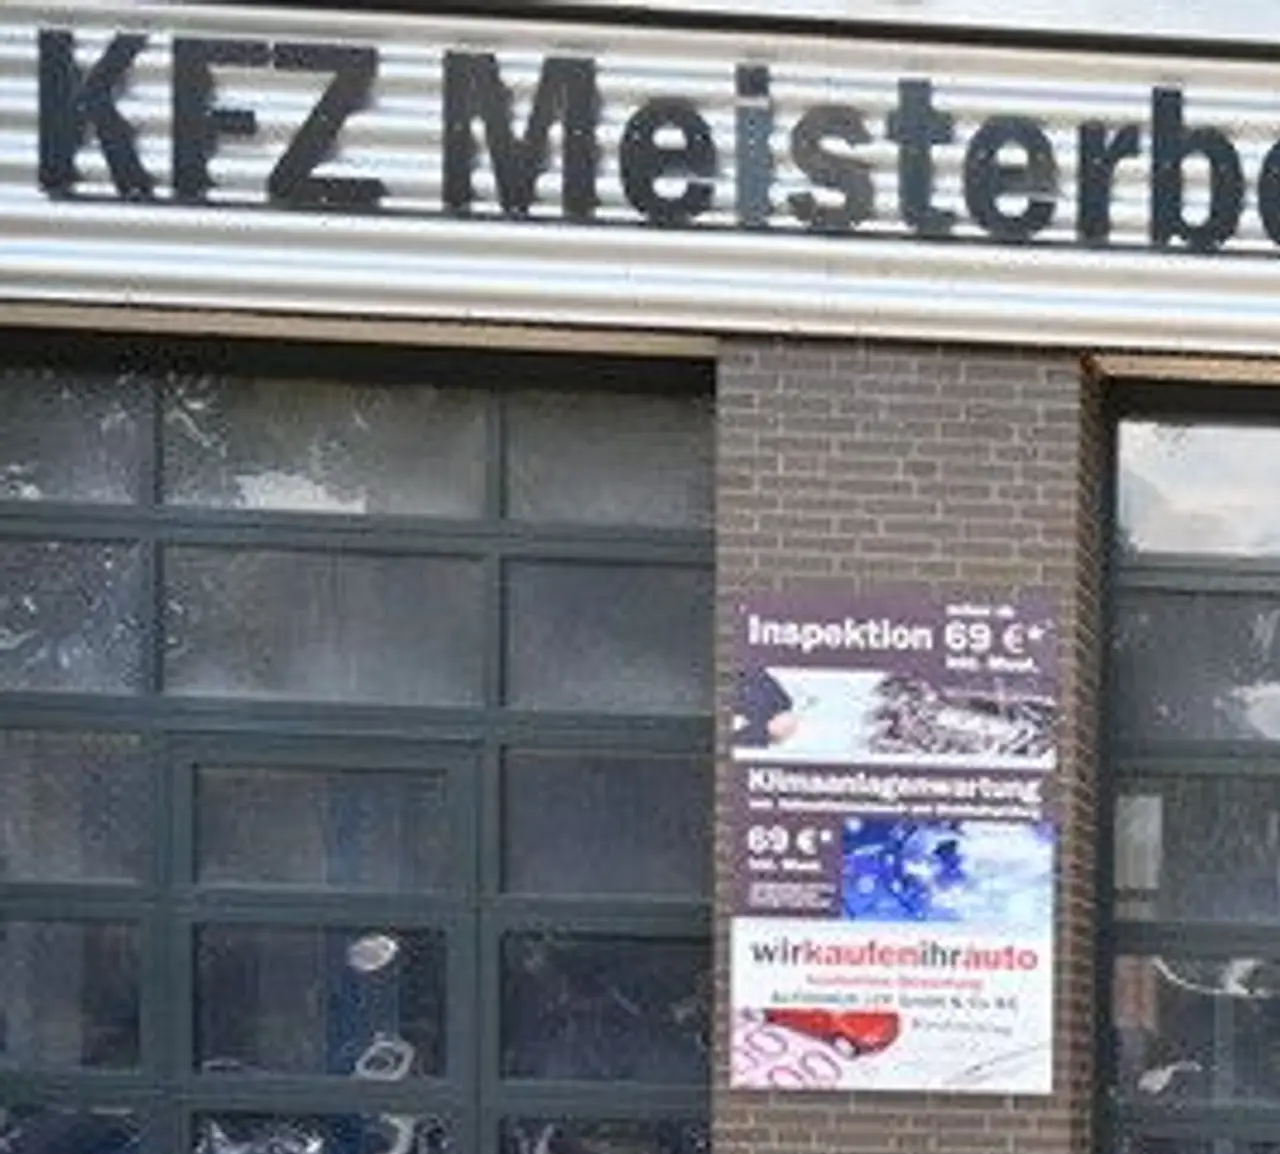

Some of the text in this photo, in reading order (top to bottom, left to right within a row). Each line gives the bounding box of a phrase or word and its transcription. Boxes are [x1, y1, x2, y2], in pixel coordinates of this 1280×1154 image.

[36, 28, 388, 206] KFZ
[748, 613, 934, 653] Inspektion
[944, 618, 993, 651] 69
[748, 765, 1044, 804] Klimaanlagenwartung
[750, 937, 1040, 971] wirkaufenihrauto
